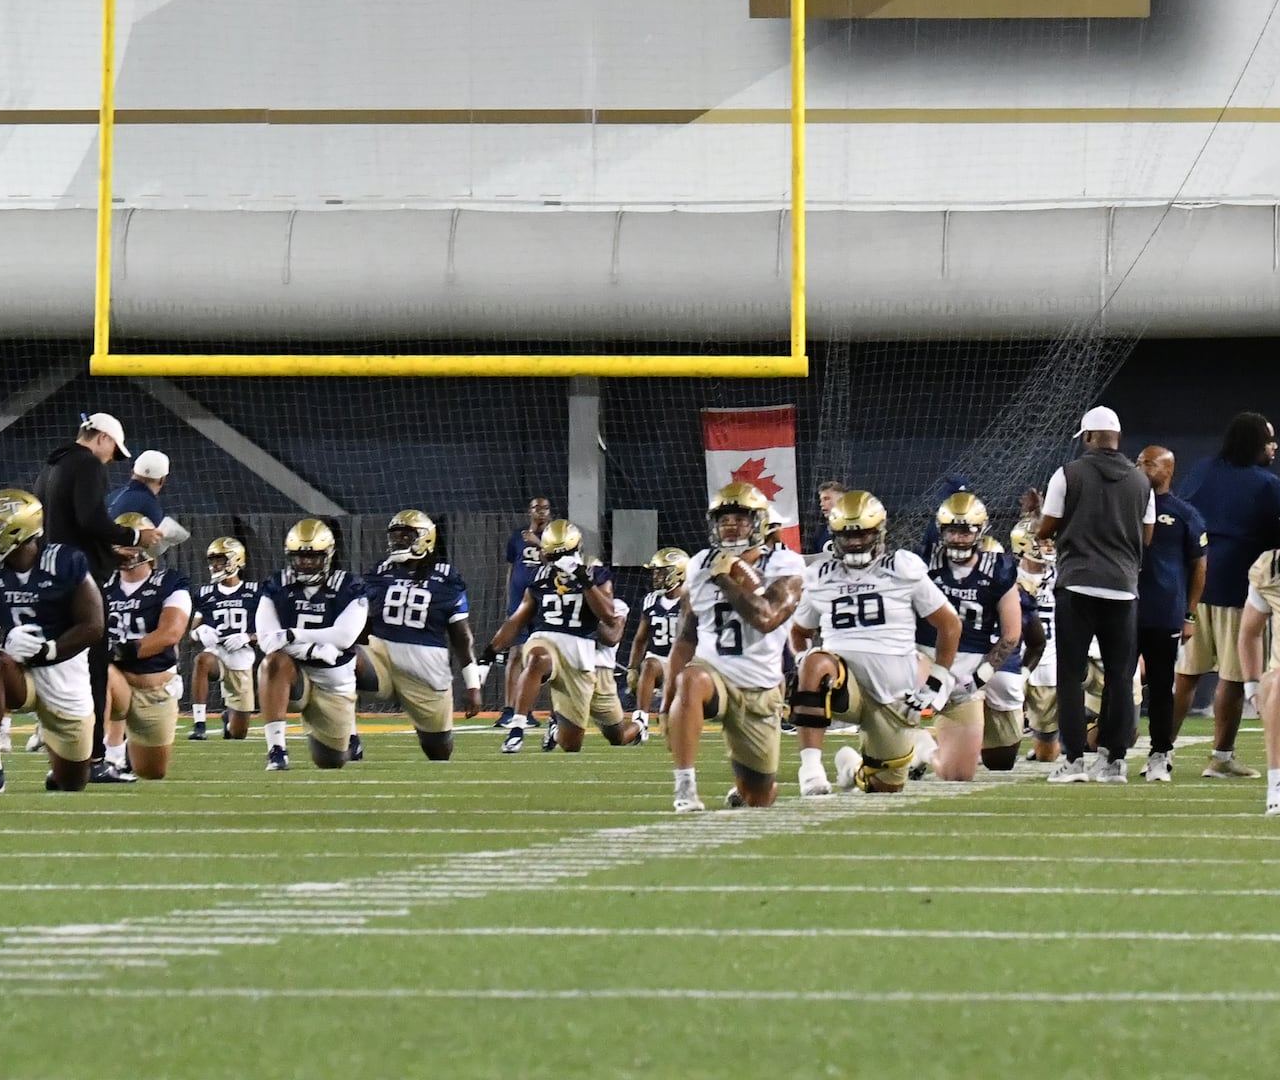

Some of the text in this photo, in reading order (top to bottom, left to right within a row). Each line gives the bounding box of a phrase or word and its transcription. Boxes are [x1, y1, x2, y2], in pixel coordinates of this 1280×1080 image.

[108, 598, 141, 611] TECH
[216, 600, 243, 608] TECH
[382, 585, 432, 629] 88
[942, 585, 978, 600] TECH
[542, 593, 584, 628] 27
[831, 593, 886, 629] 60
[714, 602, 743, 656] 6
